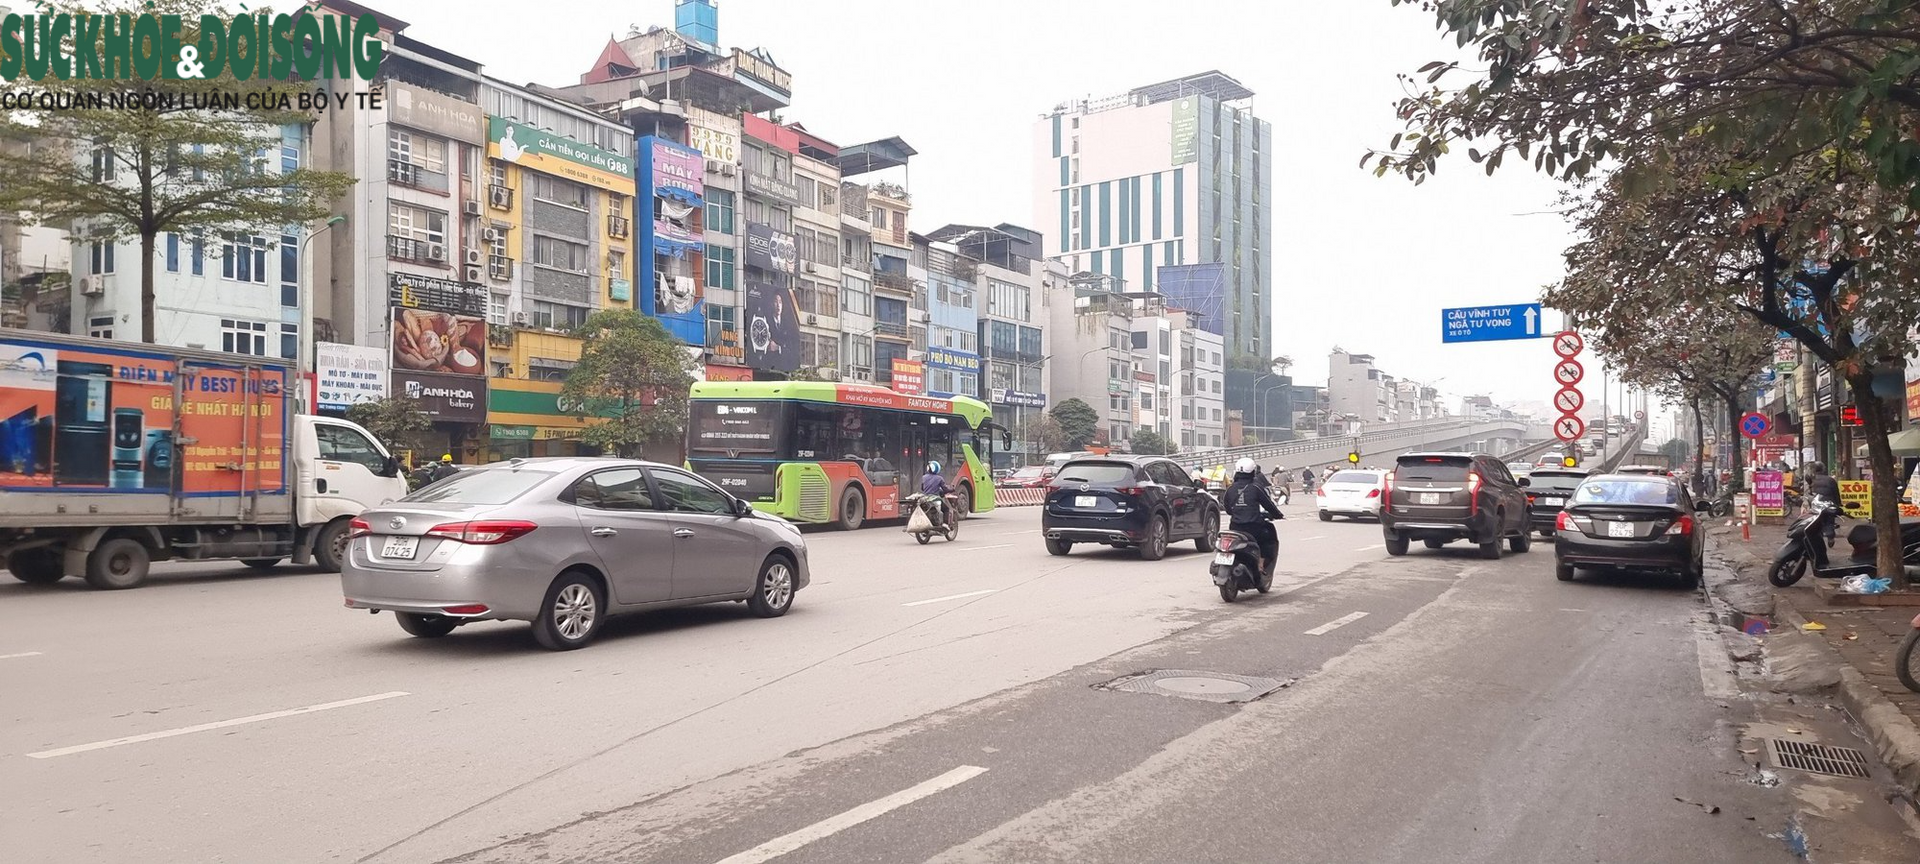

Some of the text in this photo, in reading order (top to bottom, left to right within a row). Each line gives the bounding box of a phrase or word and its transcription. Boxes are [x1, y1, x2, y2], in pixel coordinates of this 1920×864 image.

[418, 101, 447, 116] ANH
[575, 151, 590, 162] GỌI
[662, 163, 693, 178] MÁY
[749, 236, 768, 248] epos
[1448, 308, 1511, 320] CẦU VĨNH TUY
[1449, 318, 1512, 329] NGÃ TƯ VỌNG
[954, 355, 966, 367] NAM
[351, 371, 363, 379] MÁY
[201, 376, 237, 393] BEST
[336, 381, 355, 389] KHOAN
[423, 388, 449, 397] ANH
[152, 394, 173, 410] GIÁ
[196, 398, 229, 416] NHẤT
[449, 398, 474, 409] bakery
[908, 398, 948, 410] FANTASY HOME
[544, 429, 551, 438] 15
[1841, 482, 1868, 493] XÔI
